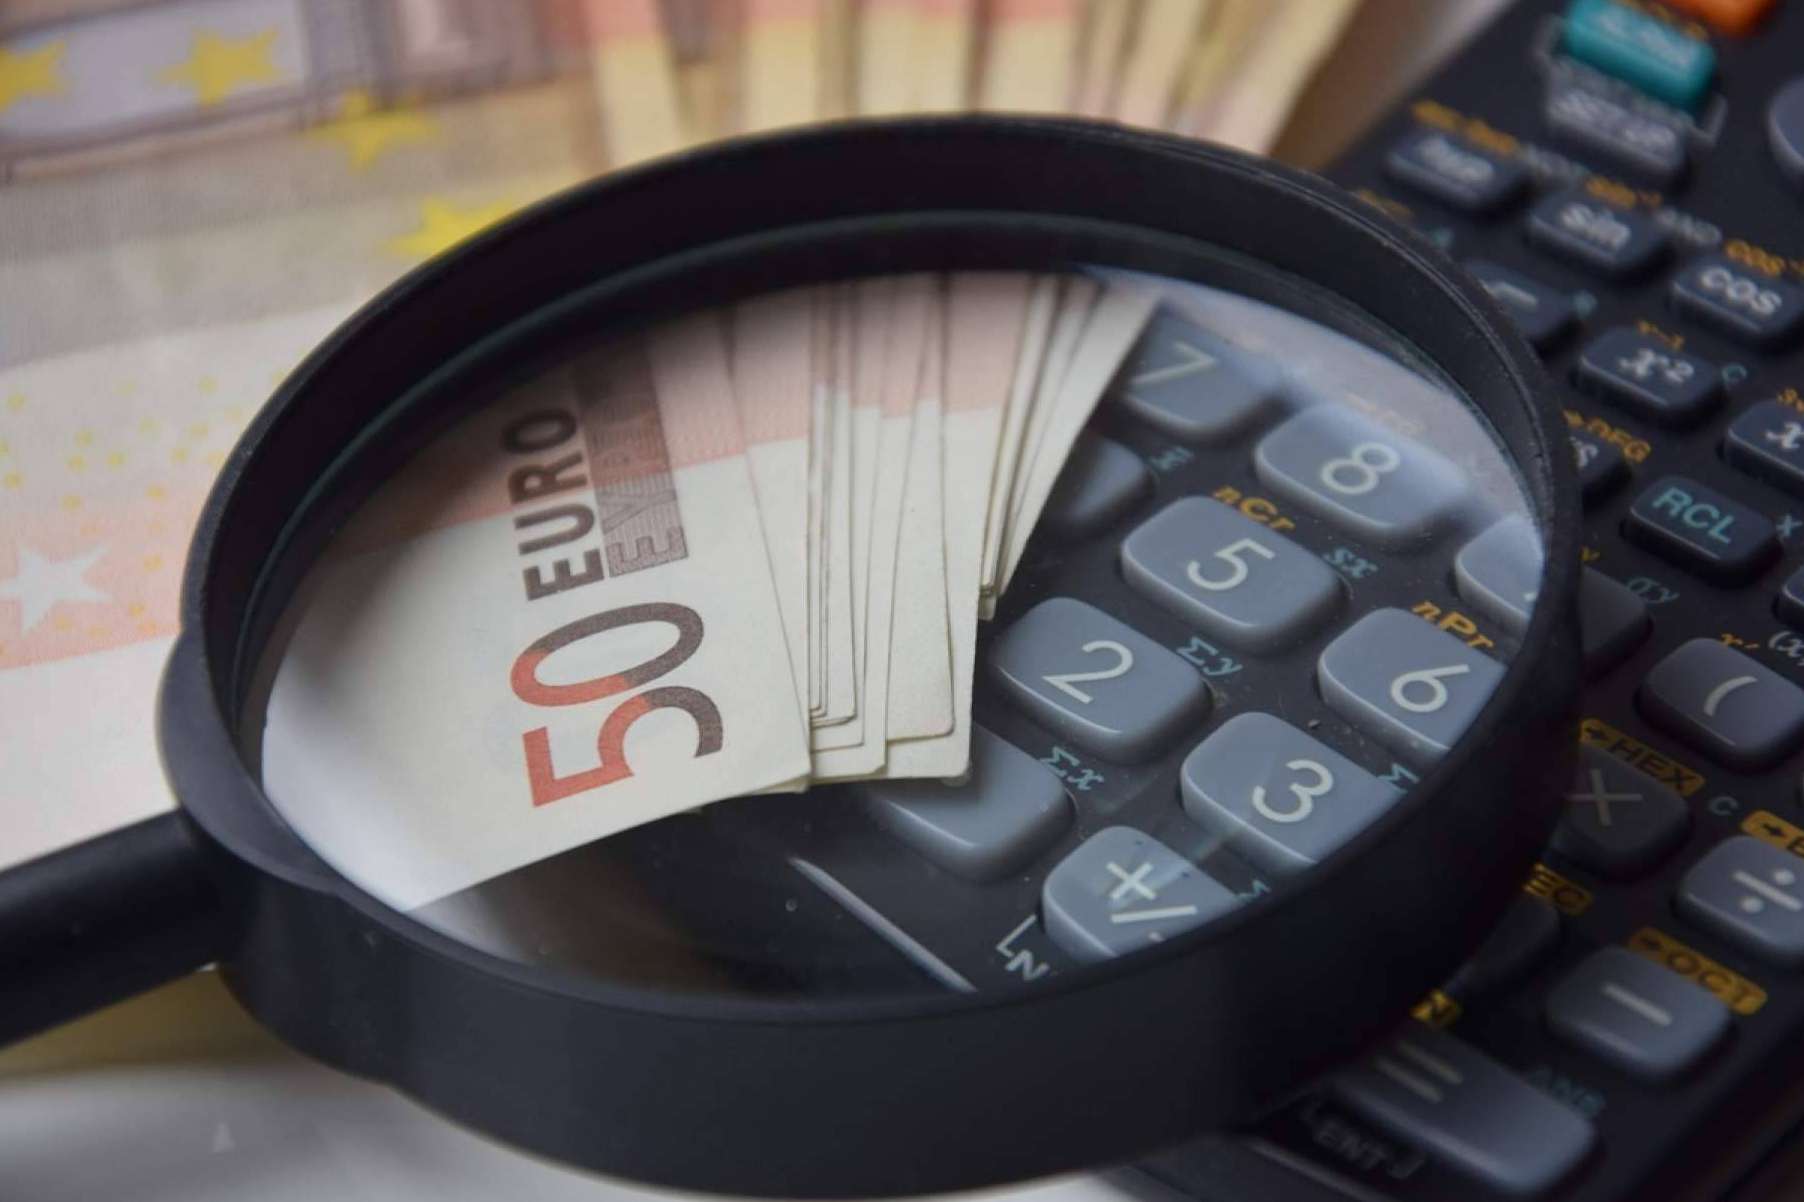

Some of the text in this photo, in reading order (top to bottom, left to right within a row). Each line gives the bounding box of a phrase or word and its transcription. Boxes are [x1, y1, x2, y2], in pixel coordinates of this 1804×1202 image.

[1129, 341, 1217, 386] 7
[1320, 441, 1400, 495] 8
[1212, 484, 1296, 534] nCr
[1652, 487, 1736, 545] RCL
[1186, 537, 1277, 591] 5
[506, 408, 724, 807] 50 EURO
[1411, 599, 1496, 651] nPr
[1041, 639, 1134, 705] 2
[1389, 663, 1471, 713] 6
[1251, 758, 1334, 824] 3
